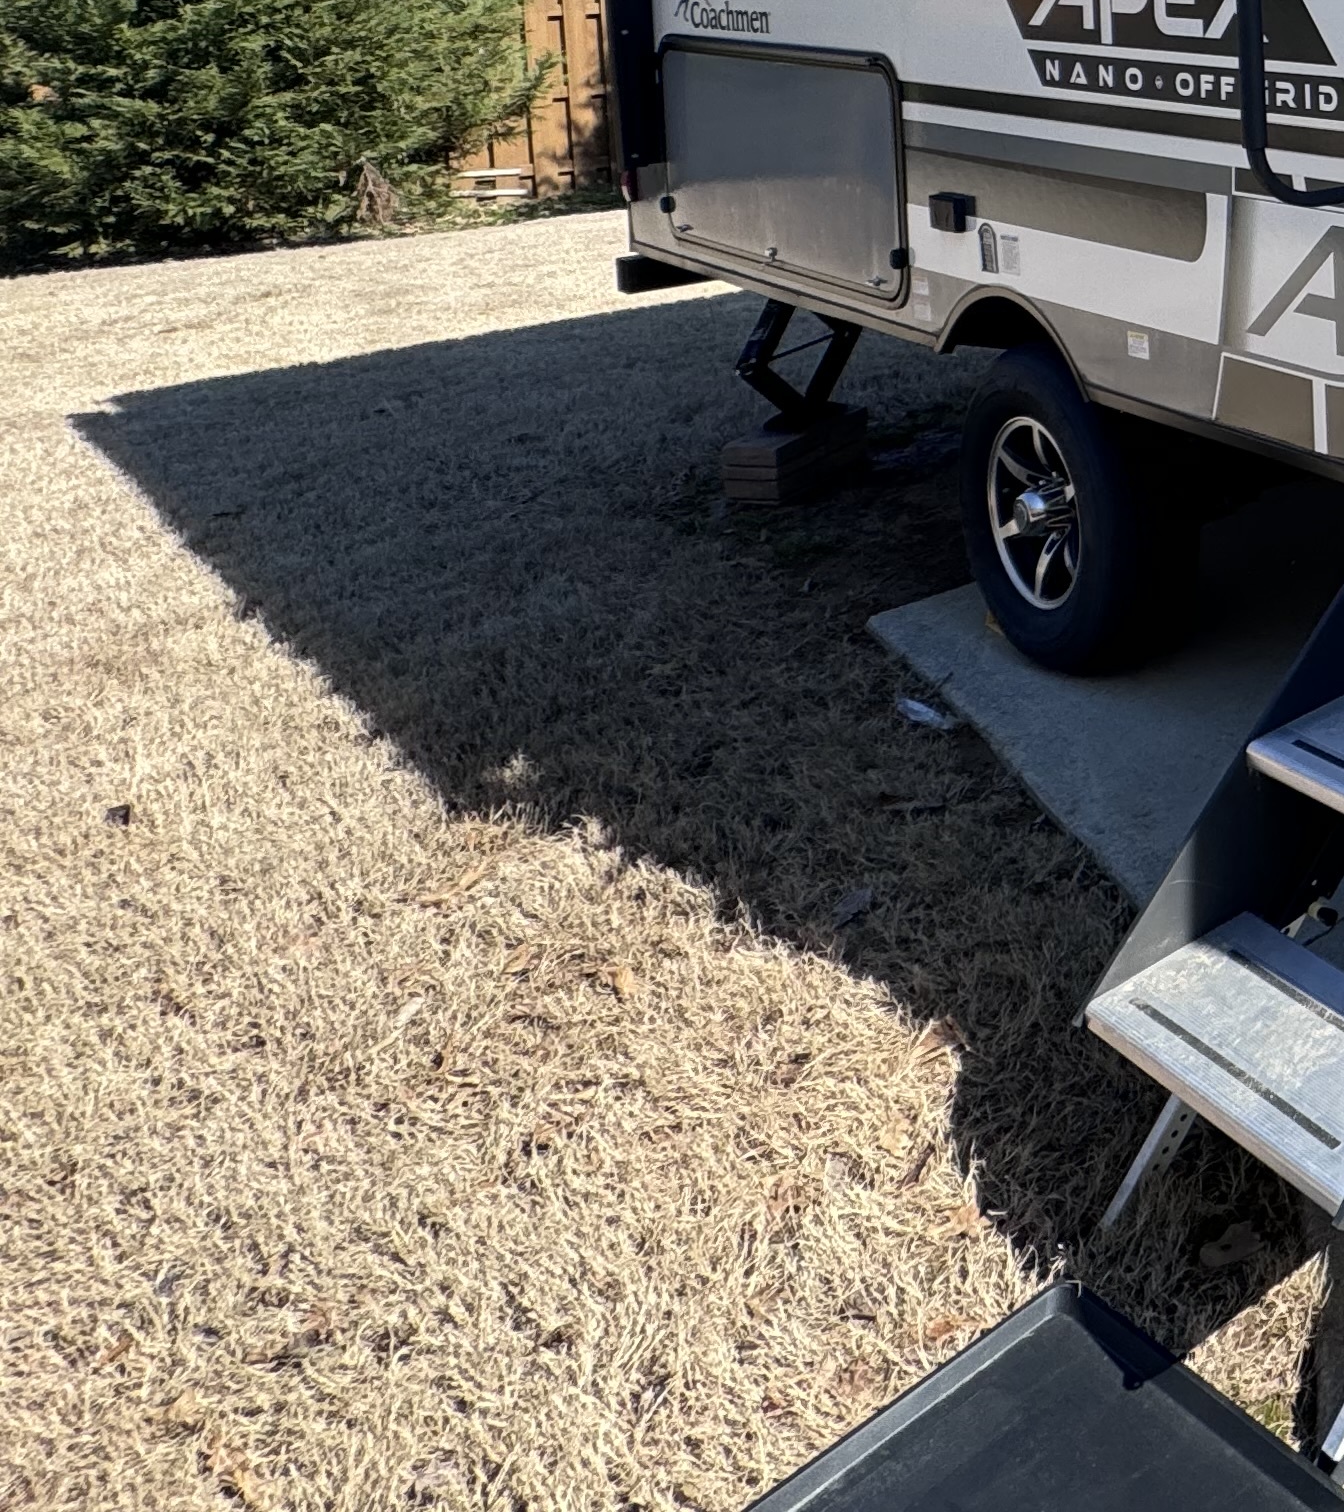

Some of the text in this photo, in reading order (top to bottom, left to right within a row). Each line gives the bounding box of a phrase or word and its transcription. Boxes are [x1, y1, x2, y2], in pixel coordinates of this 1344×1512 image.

[691, 0, 770, 34] Coachmen
[1045, 58, 1338, 113] NANO OFF RID
